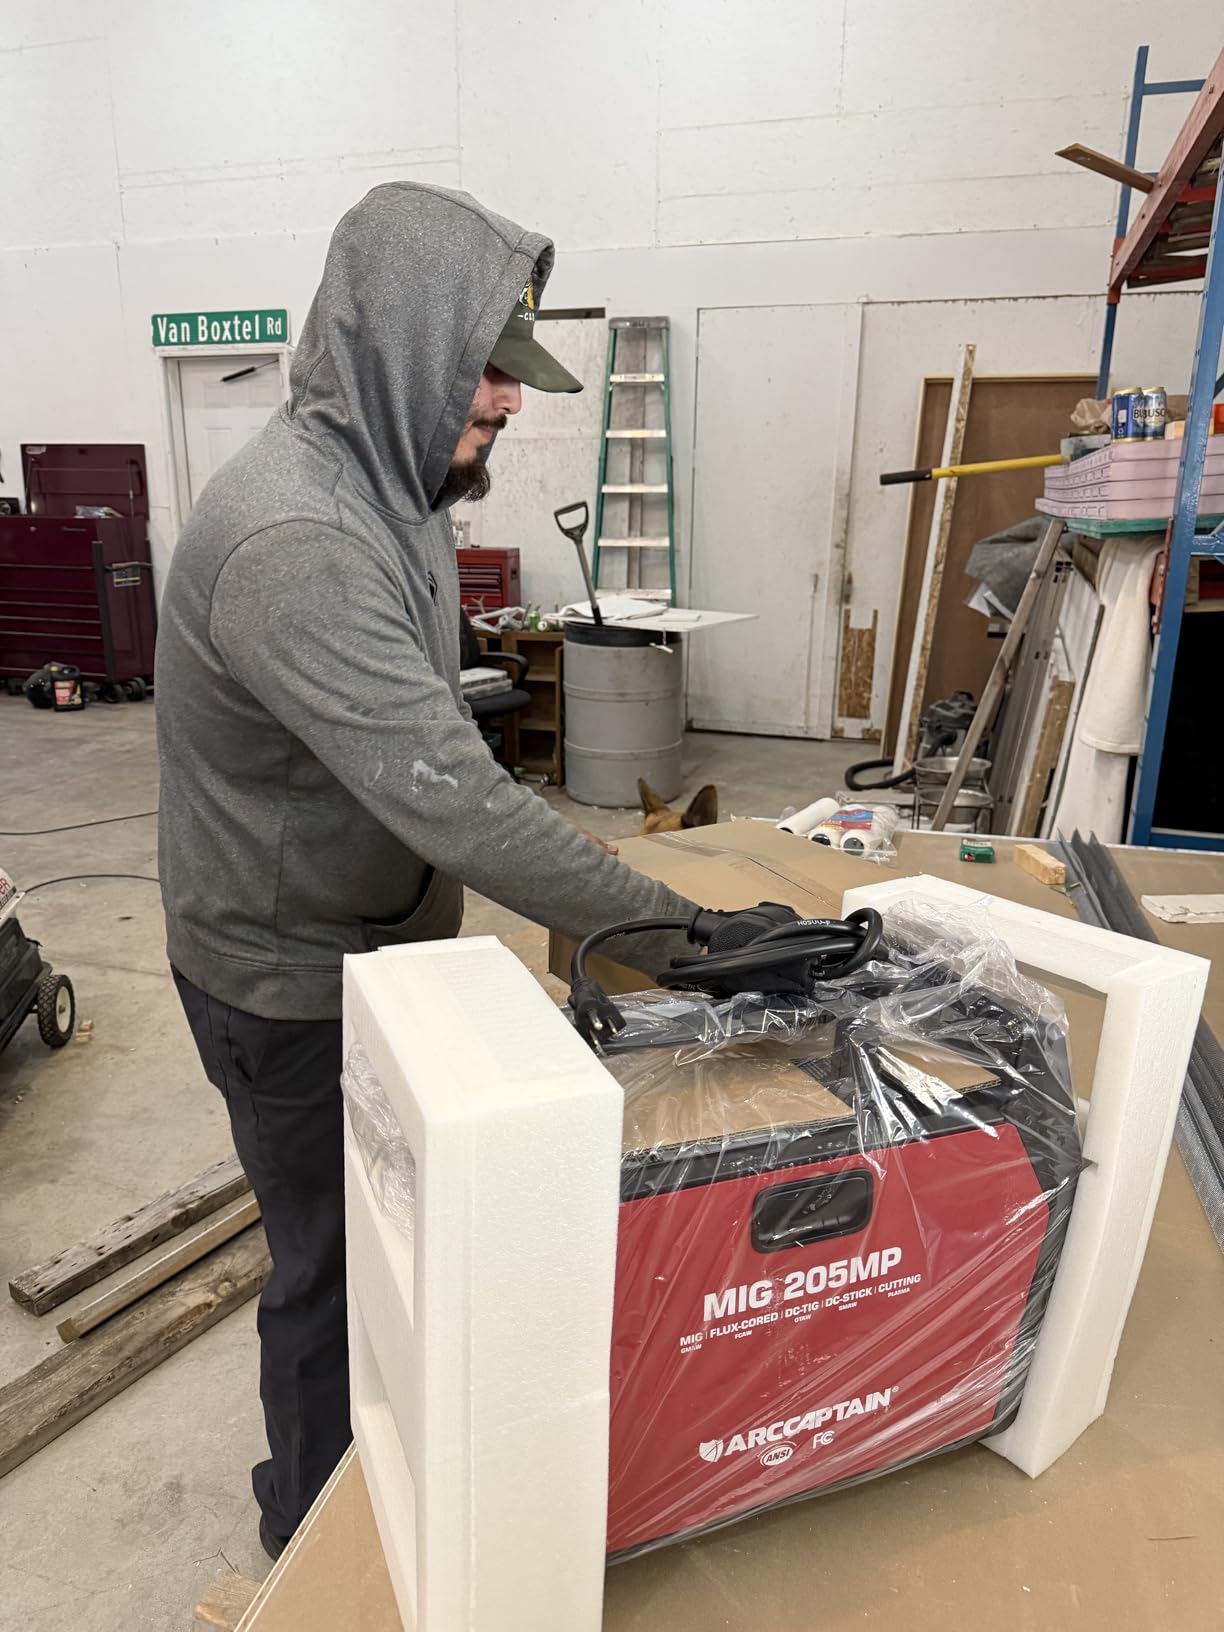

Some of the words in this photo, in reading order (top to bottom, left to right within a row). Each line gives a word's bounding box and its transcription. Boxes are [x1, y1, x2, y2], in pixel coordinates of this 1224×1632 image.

[157, 316, 191, 343] Van
[197, 314, 260, 341] Boxtel
[266, 316, 282, 335] Rd
[679, 1332, 704, 1347] MIG
[709, 1312, 779, 1339] FLUX-CORED
[784, 1301, 820, 1318] DC-TIG
[825, 1286, 873, 1308] DC-STICK
[878, 1274, 921, 1293] CUTTING
[703, 1280, 773, 1322] MIG
[783, 1246, 902, 1301] 205MP
[734, 1330, 753, 1340] FCAW
[887, 1287, 911, 1298] PLASMA
[765, 1449, 790, 1464] ANSI
